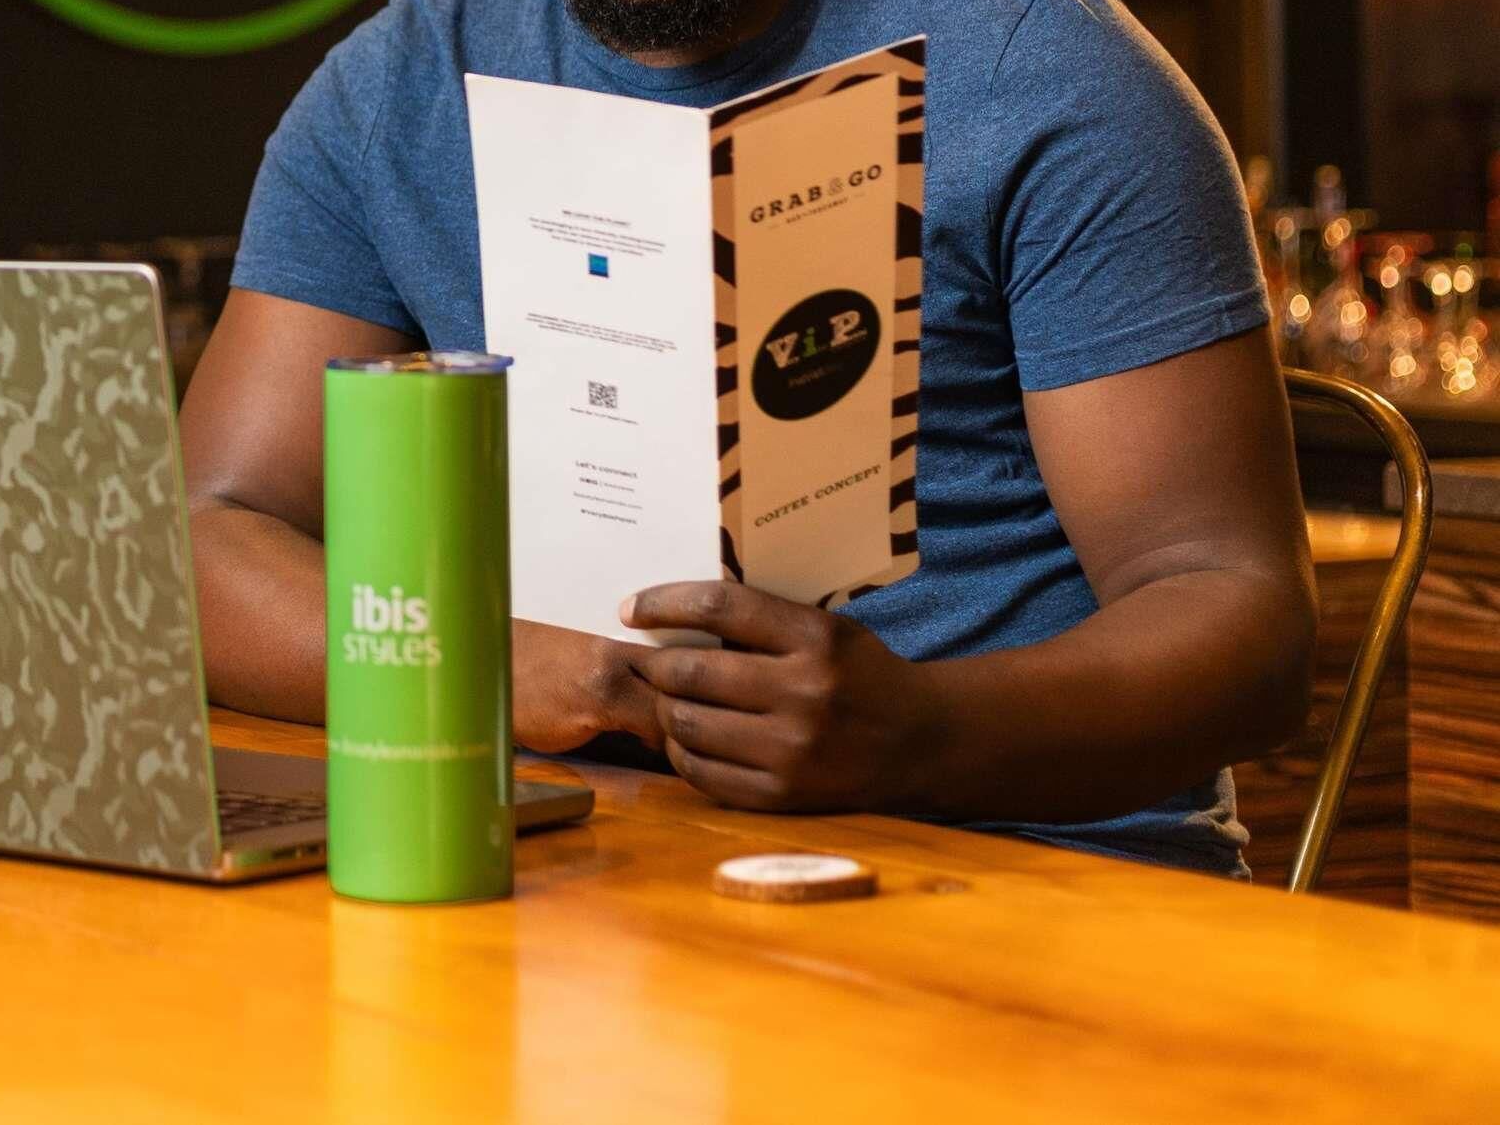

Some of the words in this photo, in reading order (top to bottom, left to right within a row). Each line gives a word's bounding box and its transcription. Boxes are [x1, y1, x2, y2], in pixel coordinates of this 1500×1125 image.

[749, 185, 827, 224] GRAB
[828, 176, 845, 197] &
[847, 163, 883, 188] GO
[753, 494, 810, 528] COFFEE
[814, 463, 882, 501] CONCEPT
[352, 583, 430, 635] ibis
